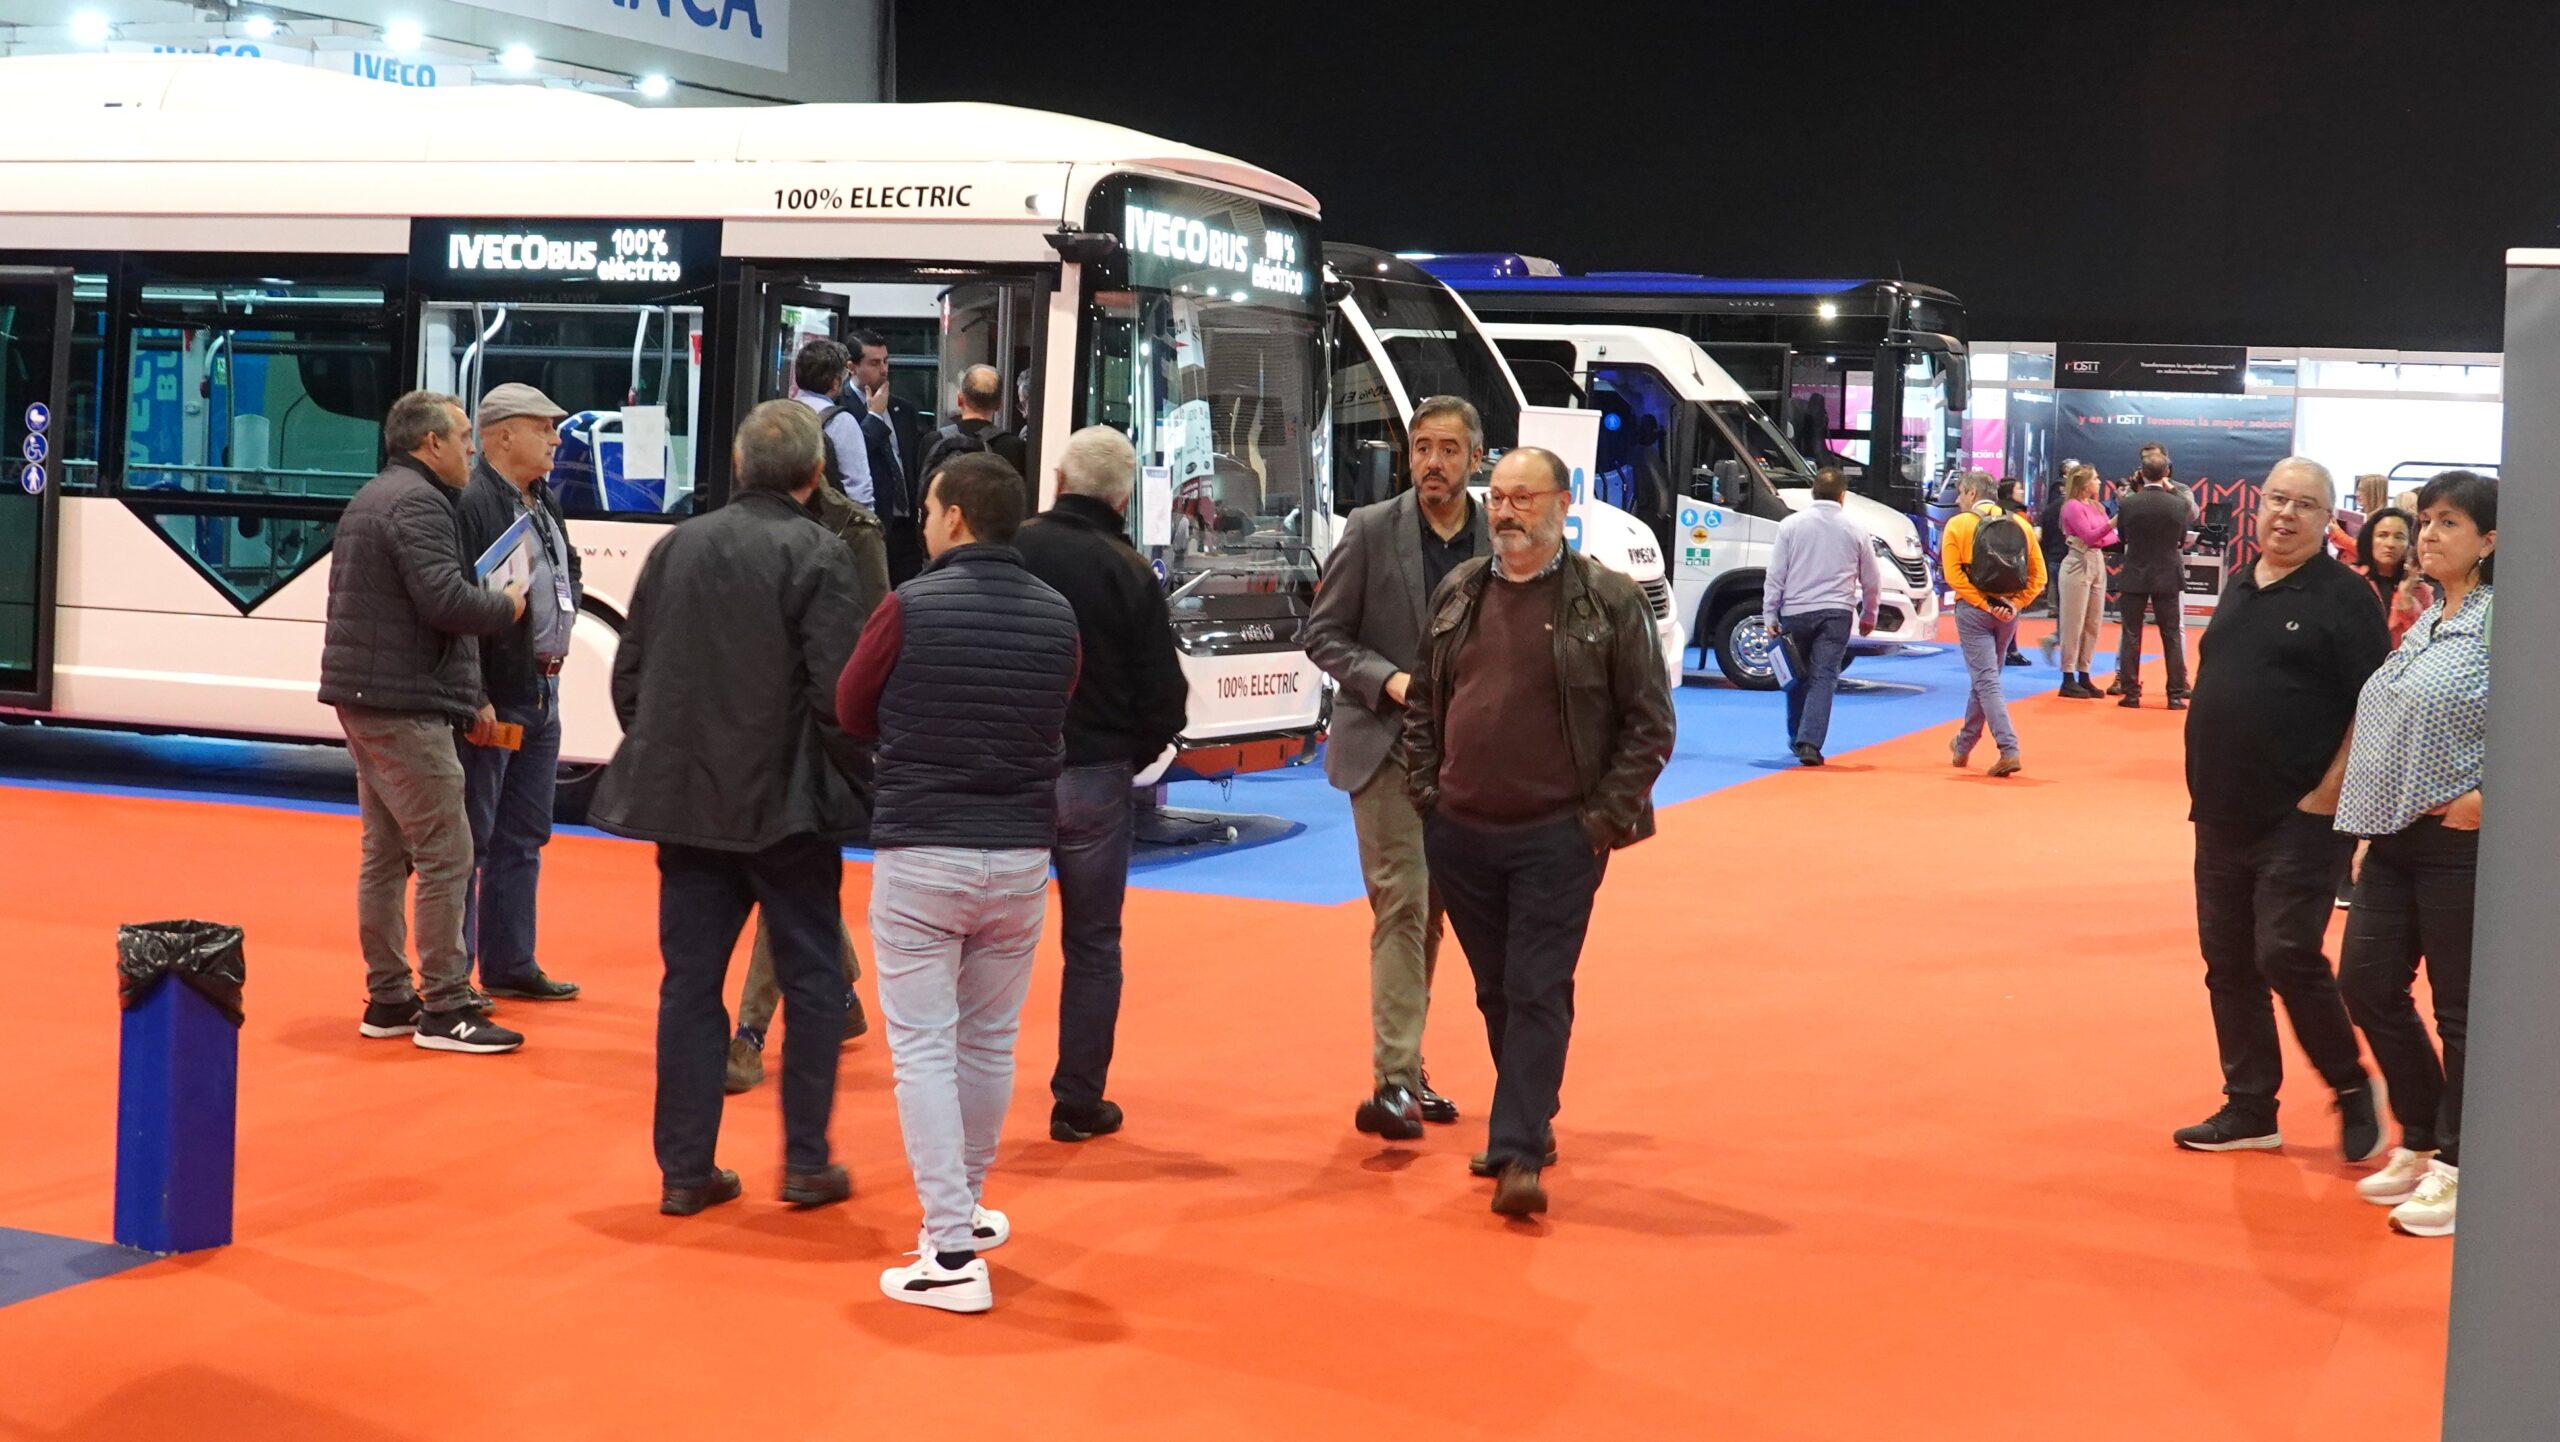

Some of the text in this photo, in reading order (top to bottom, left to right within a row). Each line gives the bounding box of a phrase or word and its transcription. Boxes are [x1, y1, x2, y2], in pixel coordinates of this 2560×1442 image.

[353, 51, 436, 87] IVECO
[774, 185, 972, 210] 100% ELECTRIC
[612, 229, 669, 257] 100%
[2147, 416, 2194, 427] tenemos
[2212, 417, 2245, 430] mejor
[1218, 671, 1299, 699] 100% ELECTRIC
